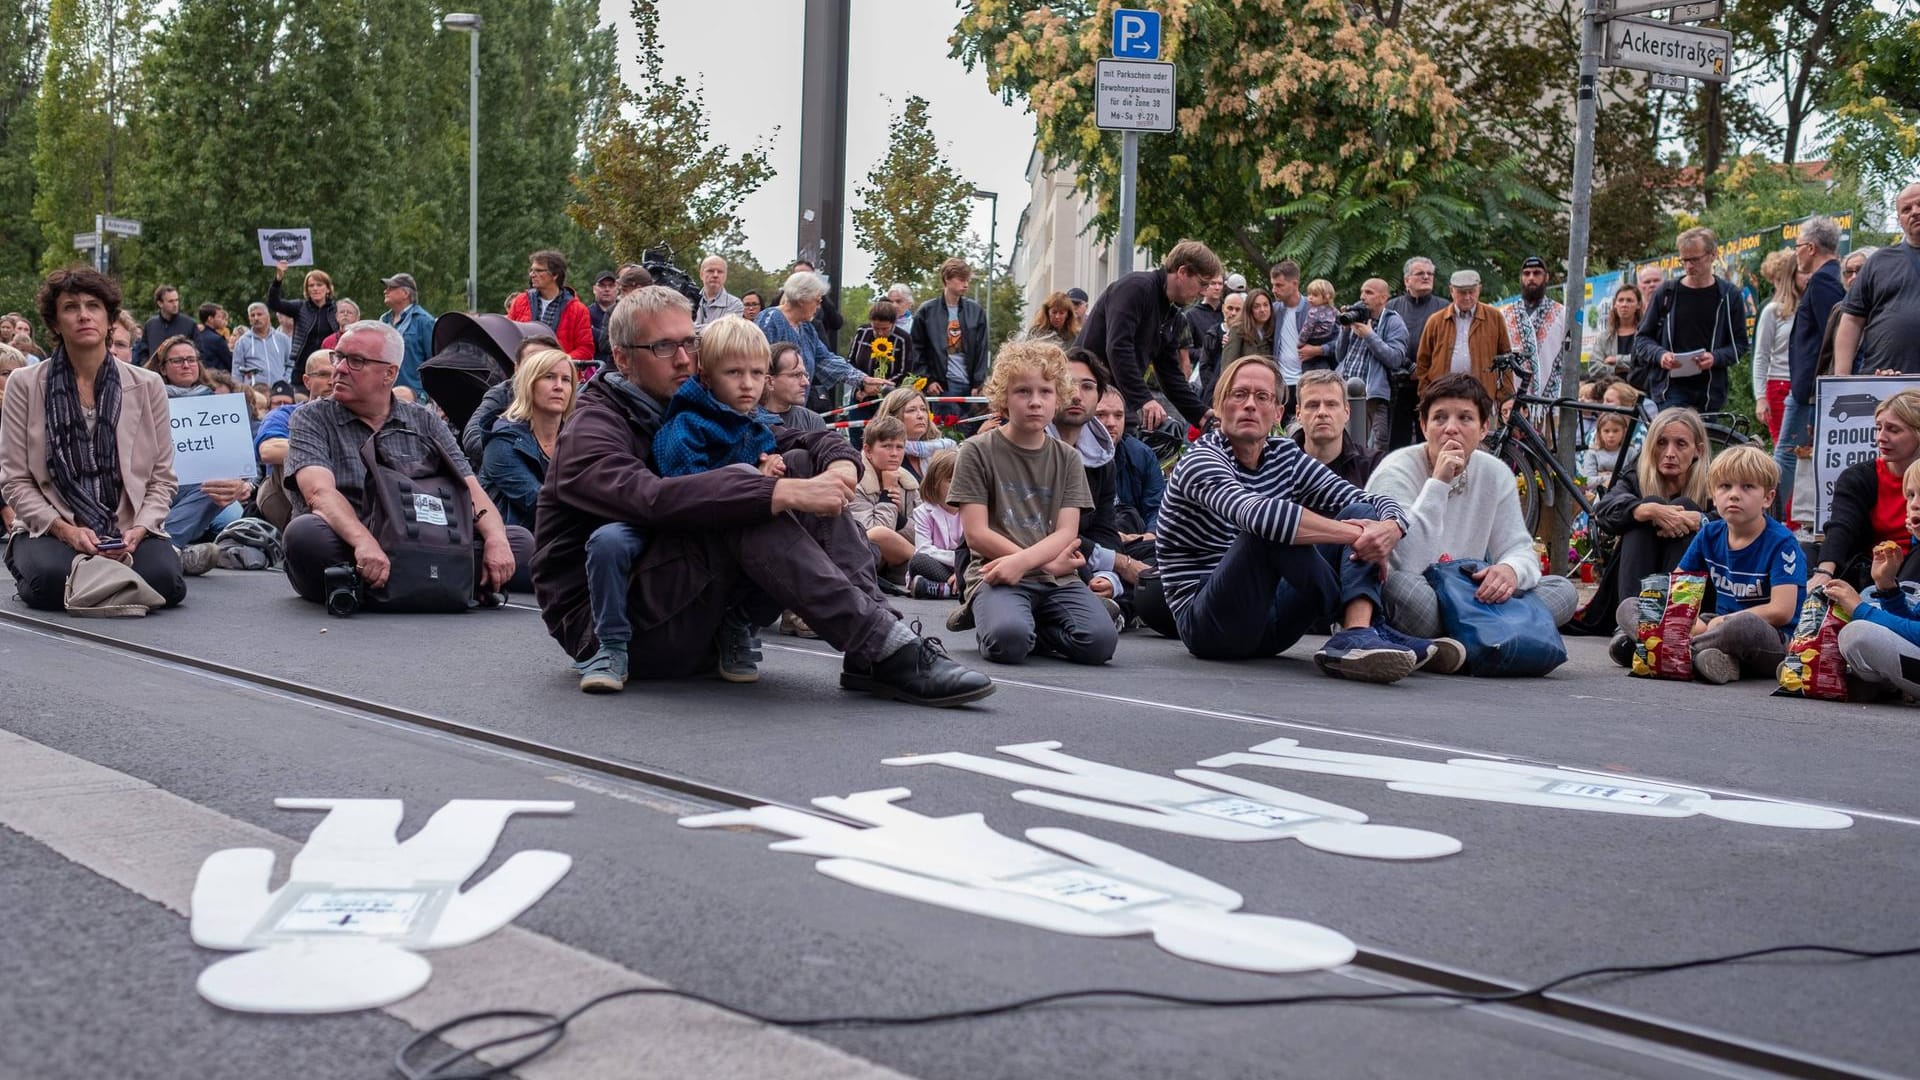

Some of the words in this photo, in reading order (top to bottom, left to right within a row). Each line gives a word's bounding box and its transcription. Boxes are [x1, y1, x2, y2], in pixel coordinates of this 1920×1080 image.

[1121, 15, 1146, 52] P
[1620, 28, 1718, 68] Ackerstraße
[1103, 70, 1114, 78] mit
[1116, 70, 1151, 80] Parkschein
[1153, 72, 1168, 80] oder
[1100, 82, 1170, 94] Bewohnerparkausweis
[1110, 97, 1119, 106] für
[1122, 98, 1132, 106] die
[1135, 98, 1150, 107] Zone
[197, 411, 240, 427] Zero
[172, 435, 215, 453] etzt!
[1827, 427, 1879, 448] enoug
[1825, 448, 1842, 469] is
[1846, 450, 1880, 468] eno
